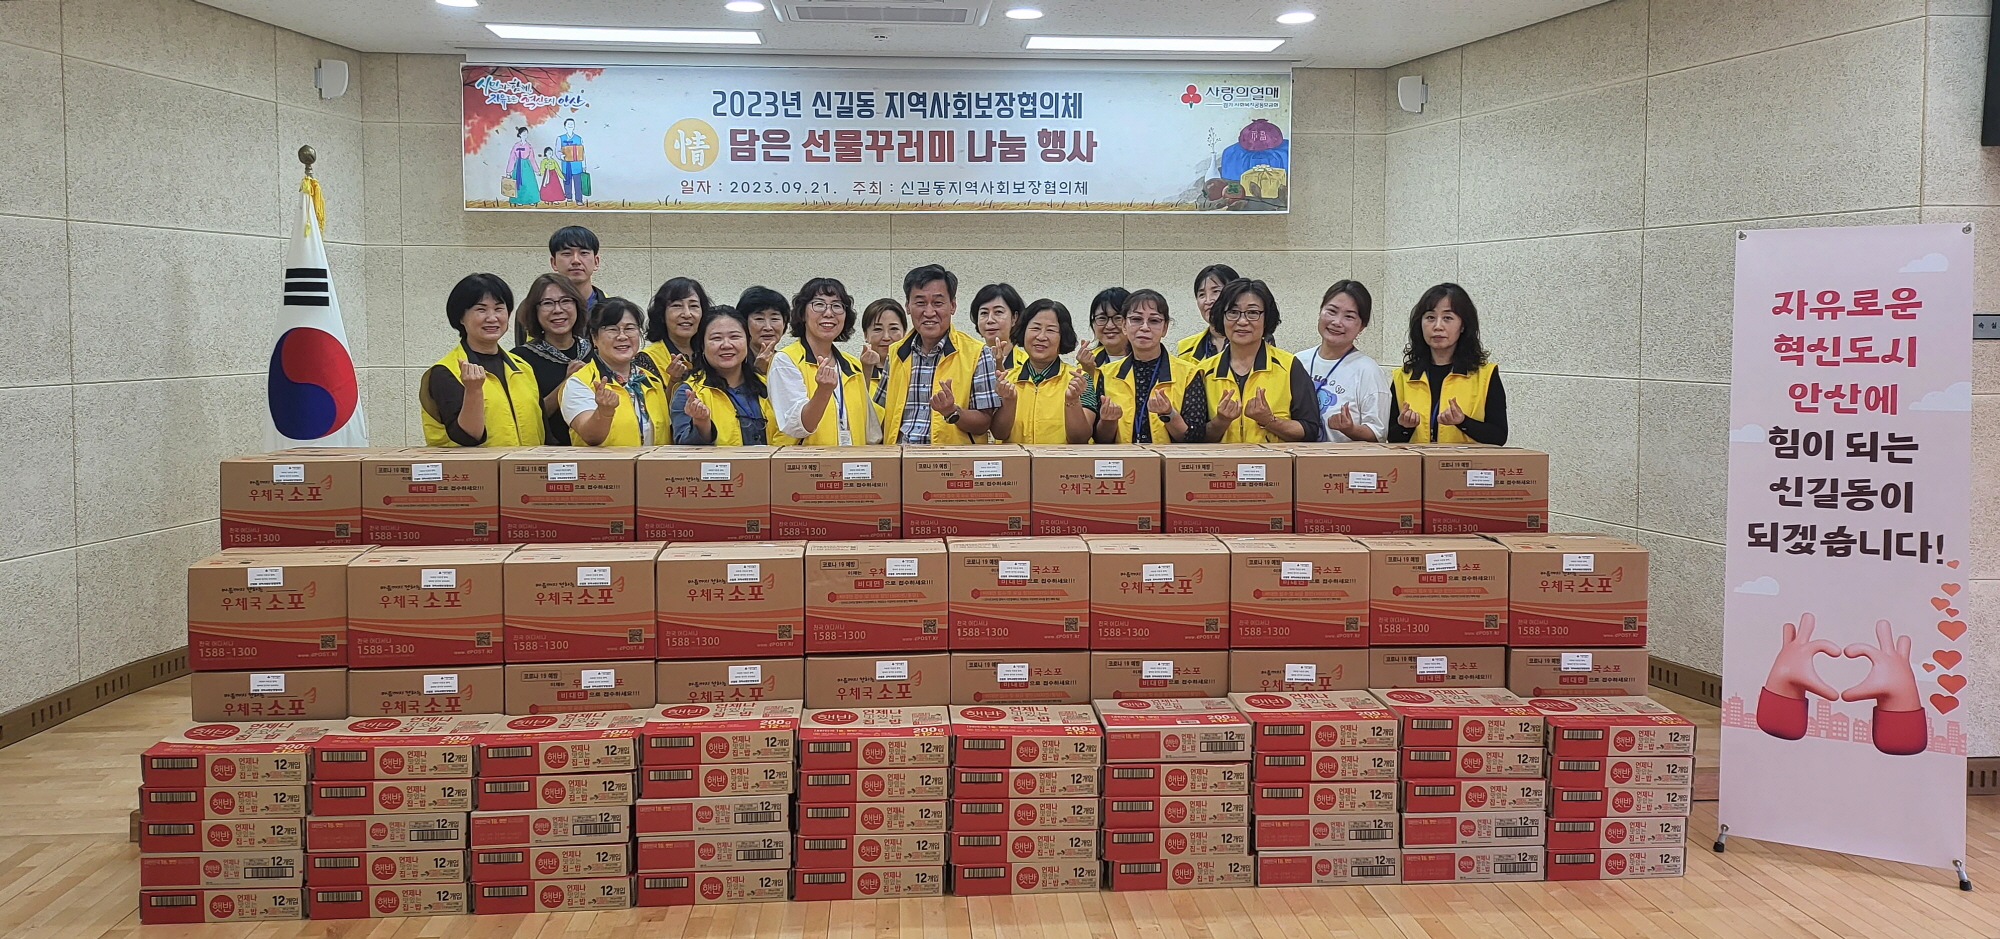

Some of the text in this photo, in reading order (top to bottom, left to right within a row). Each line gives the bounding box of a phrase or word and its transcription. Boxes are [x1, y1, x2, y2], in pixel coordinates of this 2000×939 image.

[1206, 87, 1279, 101] 사랑의열매
[558, 95, 585, 106] 안산
[712, 90, 1083, 119] 2023년 신길동 지역사회보장협의체
[673, 128, 1098, 166] 情 담은 선물꾸러미 나눔 행사
[681, 180, 711, 194] 일자
[730, 181, 837, 194] 2023.09.21.
[852, 181, 882, 196] 주최
[901, 181, 1089, 196] 신길동지역사회보장협의체
[1772, 288, 1923, 320] 자유로운
[1774, 334, 1917, 367] 혁신도시
[1788, 383, 1898, 415] 안산에
[1768, 425, 1919, 464] 힘이 되는
[664, 484, 735, 497] 우체국 소포
[1059, 480, 1127, 495] 우체국 소포
[249, 487, 323, 501] 우체국 소포
[1769, 477, 1913, 513] 신길동이
[910, 526, 957, 534] 1588-1300
[1304, 525, 1350, 533] 1588-1300
[1432, 524, 1478, 532] 1588-1300
[230, 534, 280, 542] 1588-1300
[369, 532, 420, 540] 1588-1300
[508, 530, 557, 538] 1588-1300
[645, 530, 694, 538] 1588-1300
[1748, 522, 1944, 564] 되겠습니다!
[1119, 579, 1193, 594] 우체국 소포
[1539, 578, 1613, 593] 우체국 소포
[535, 589, 614, 605] 우체국 소포
[687, 585, 765, 601] 우체국 소포
[221, 594, 306, 611] 우체국 소포
[380, 591, 462, 608] 우체국 소포
[957, 628, 1009, 637] 1588-1300
[1098, 628, 1150, 637] 1588-1300
[1239, 627, 1290, 636] 1588-1300
[1378, 624, 1429, 633] 1588-1300
[1518, 626, 1569, 635] 1588-1300
[813, 631, 866, 640] 1588-1300
[514, 641, 569, 650] 1588-1300
[666, 637, 720, 646] 1588-1300
[199, 647, 257, 658] 1588-1300
[357, 644, 414, 654] 1588-1300
[836, 683, 912, 700] 우체국 소포
[223, 699, 306, 716] 우체국 소포
[380, 697, 462, 714] 우체국 소포
[817, 714, 853, 722] 햇반
[966, 710, 1001, 718] 햇반
[1371, 727, 1394, 736] 12개입
[1465, 726, 1484, 737] 햇반
[1519, 722, 1540, 732] 12개입
[1224, 731, 1245, 740] 12개입
[1317, 731, 1336, 742] 햇반
[1669, 732, 1690, 741] 12개입
[765, 737, 789, 747] 12개입
[1074, 742, 1097, 752] 12개입
[1165, 738, 1179, 747] 햇반
[1616, 736, 1634, 747] 햇반
[605, 745, 630, 756] 12개입
[708, 742, 728, 754] 햇반
[920, 743, 944, 752] 12개입
[1019, 746, 1038, 758] 햇반
[442, 752, 467, 763] 12개입
[547, 752, 566, 764] 햇반
[865, 748, 884, 759] 햇반
[238, 757, 259, 766] 언제나
[274, 759, 300, 770] 12개입
[382, 757, 402, 769] 햇반
[213, 764, 234, 776] 햇반
[1370, 790, 1393, 800] 12개입
[1468, 792, 1486, 803] 햇반
[1521, 788, 1542, 797] 12개입
[1666, 793, 1688, 802] 12개입
[1316, 794, 1335, 806] 햇반
[1614, 797, 1632, 809] 햇반
[760, 802, 781, 811] 12개입
[1071, 805, 1094, 815] 12개입
[1221, 802, 1244, 812] 12개입
[599, 813, 621, 822] 12개입
[697, 810, 712, 819] 햇반
[919, 809, 942, 819] 12개입
[1016, 809, 1035, 821] 햇반
[1167, 807, 1186, 818] 햇반
[436, 819, 459, 828] 12개입
[863, 813, 882, 825] 햇반
[271, 825, 297, 835] 12개입
[371, 827, 386, 836] 햇반
[534, 822, 550, 831] 햇반
[209, 830, 231, 842] 햇반
